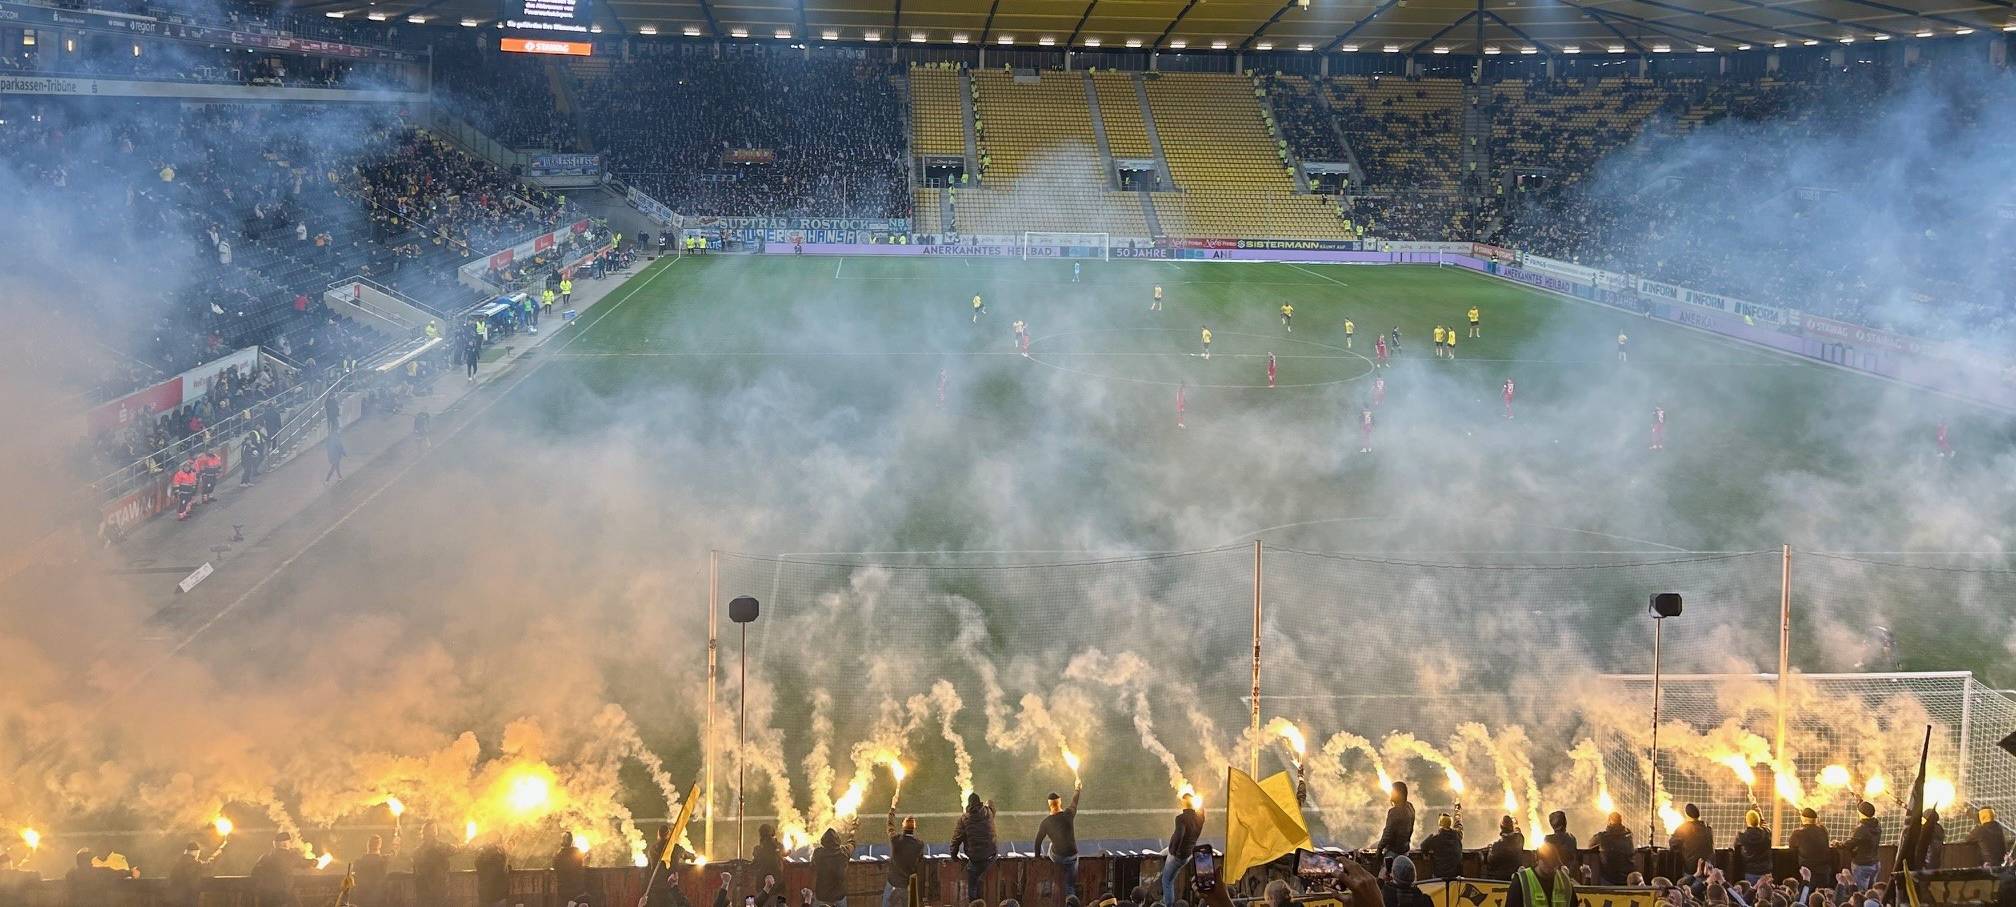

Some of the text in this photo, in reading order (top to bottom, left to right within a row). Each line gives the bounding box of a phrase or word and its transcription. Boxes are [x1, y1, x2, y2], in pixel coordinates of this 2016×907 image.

[0, 79, 76, 92] parkassen-Tribüne
[800, 219, 869, 230] ROSTOCK
[806, 230, 856, 243] HANSA
[1246, 240, 1319, 249] SISTERMANN
[923, 247, 1001, 257] ANERKANNTES
[1116, 248, 1167, 258] 50 JAHRE
[1504, 267, 1542, 285] ANERKANNTES
[1648, 282, 1677, 299] INFORM
[1692, 293, 1725, 310] INFORM
